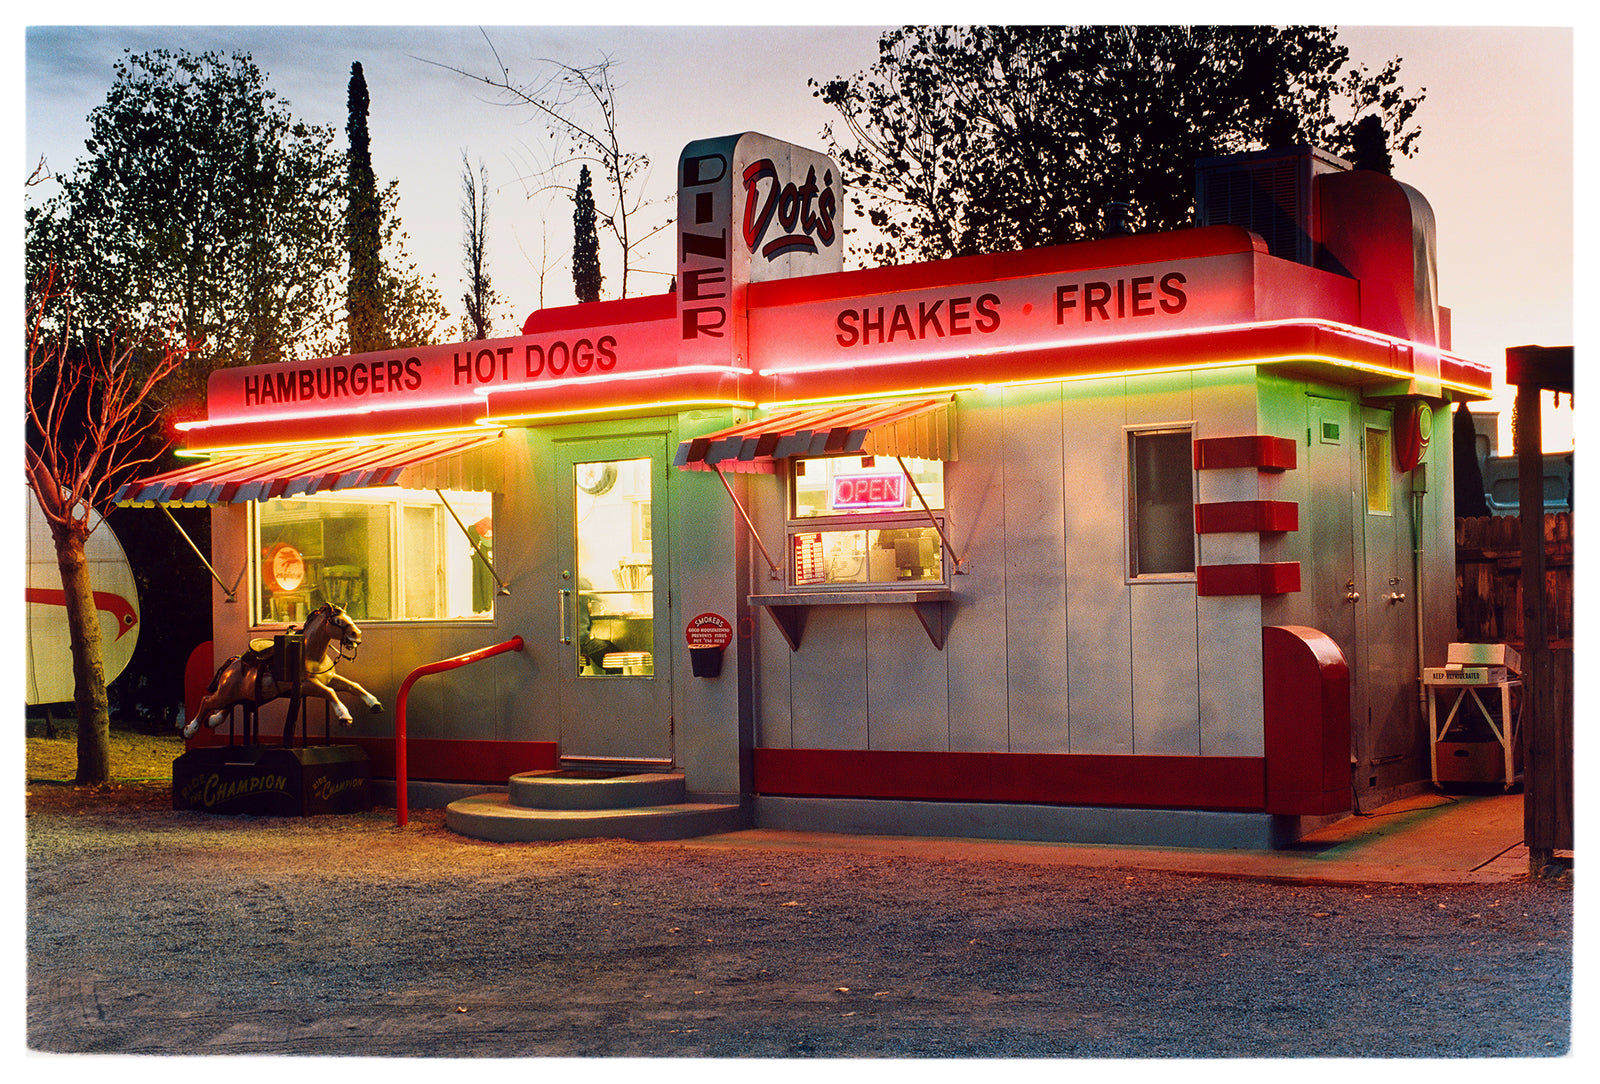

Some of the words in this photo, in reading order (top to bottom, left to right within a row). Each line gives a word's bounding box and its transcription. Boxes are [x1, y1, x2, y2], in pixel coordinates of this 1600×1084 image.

[682, 153, 728, 340] DINER
[835, 293, 1001, 348] SHAKES
[1055, 271, 1188, 325] FRIES
[244, 357, 422, 406] HAMBURGERS
[453, 347, 514, 386] HOT
[525, 335, 618, 378] DOGS
[837, 478, 899, 502] OPEN
[695, 617, 724, 627] SMOKERS
[182, 774, 206, 799] RIDE
